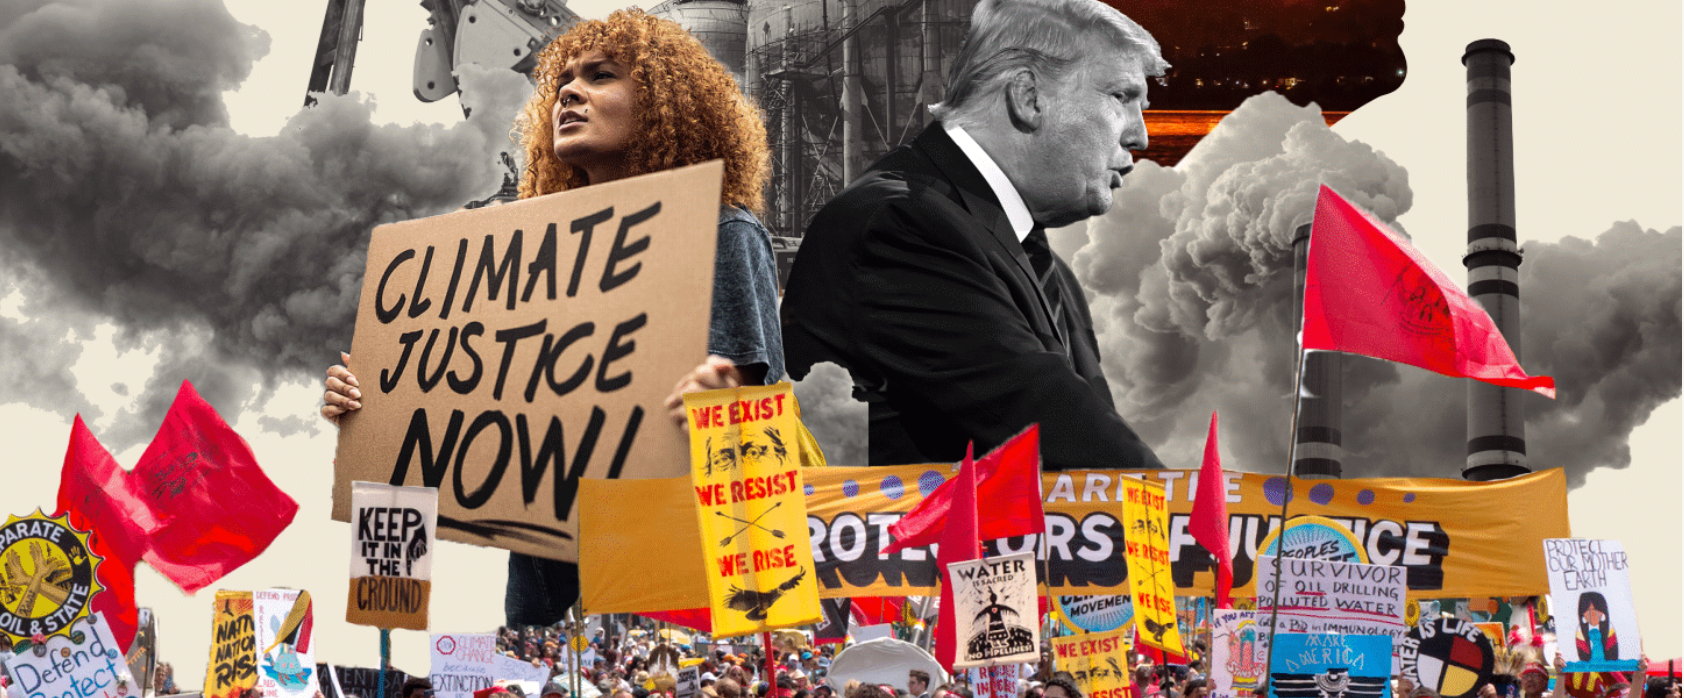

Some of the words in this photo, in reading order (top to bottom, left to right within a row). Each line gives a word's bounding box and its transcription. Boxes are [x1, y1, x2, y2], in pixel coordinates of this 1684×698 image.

[375, 201, 662, 324] CLIMATE
[380, 312, 648, 403] JUSTICE
[692, 405, 725, 430] WE
[729, 393, 786, 425] EXIST
[389, 404, 644, 521] NOW!
[695, 484, 727, 507] WE
[730, 470, 798, 503] RESIST
[1126, 487, 1140, 505] WE
[359, 507, 422, 543] KEEP
[0, 521, 65, 552] PARATE
[362, 541, 379, 557] IT
[384, 542, 401, 559] IN
[1126, 540, 1140, 559] WE
[1546, 539, 1602, 557] PROTECT
[366, 559, 400, 576] THE
[717, 553, 750, 577] WE
[753, 544, 798, 573] RISE
[957, 560, 1026, 580] WATER
[1270, 558, 1400, 584] SURVIVOR
[1549, 555, 1577, 573] OUR
[1580, 551, 1629, 572] MOTHER
[981, 575, 1013, 587] SACRED
[1265, 580, 1287, 592] OF
[1294, 580, 1326, 592] OIL
[1333, 581, 1398, 601] DRILLING
[1563, 569, 1607, 590] EARTH
[357, 579, 422, 614] GROUND
[1070, 596, 1131, 617] MOVEMEN
[1138, 592, 1152, 609] WE
[1258, 595, 1328, 608] POLUTED
[1335, 598, 1399, 618] WATER
[0, 612, 26, 636] OIL
[30, 620, 42, 636] &
[45, 583, 90, 632] STATE
[1305, 634, 1346, 647] MAKE
[1323, 623, 1403, 639] IMMUNOLOGY
[1419, 621, 1436, 639] IS
[1441, 617, 1482, 643] LIFE
[969, 650, 984, 660] NO
[1056, 643, 1078, 658] WE
[1080, 636, 1120, 656] EXIST
[14, 626, 108, 695] Defend
[1286, 646, 1364, 672] AMERICA
[29, 658, 119, 698] tect
[432, 674, 494, 693] EXTINCTION
